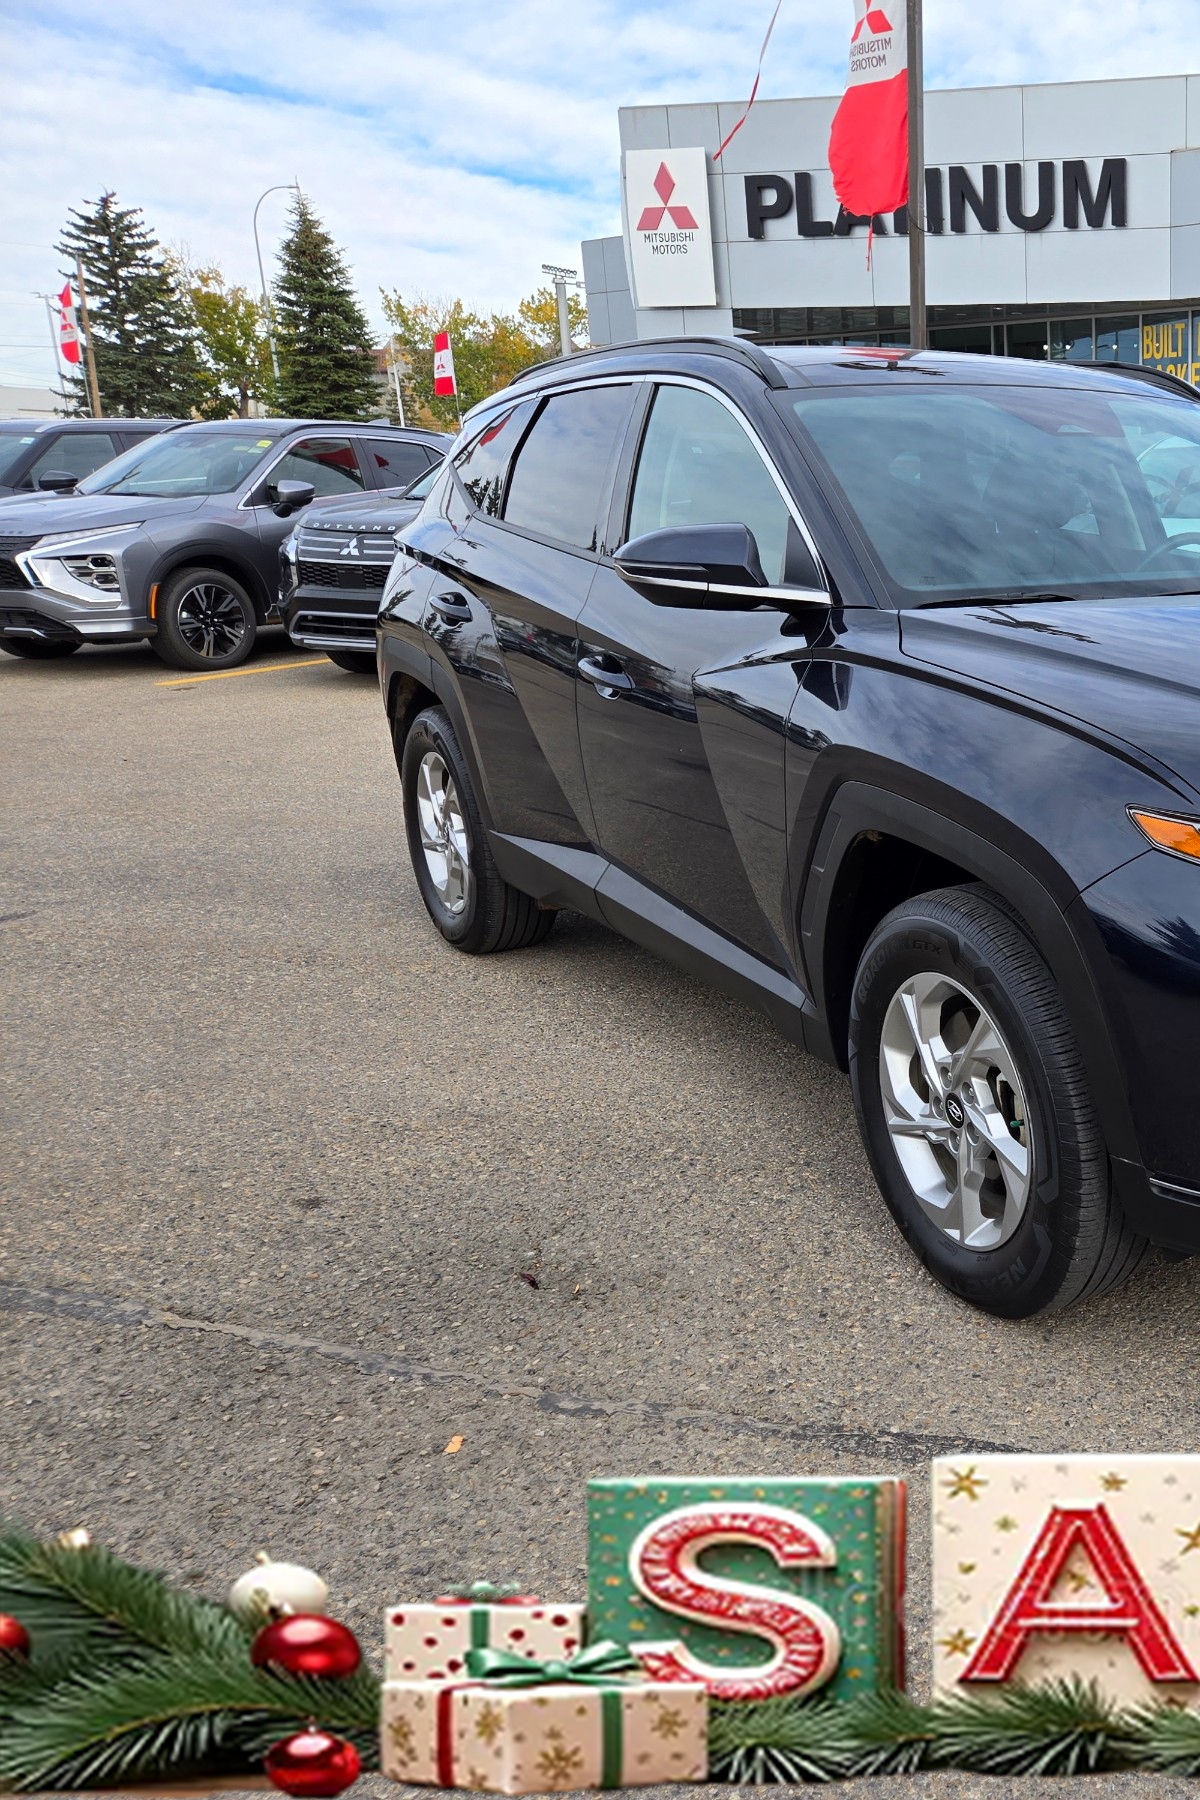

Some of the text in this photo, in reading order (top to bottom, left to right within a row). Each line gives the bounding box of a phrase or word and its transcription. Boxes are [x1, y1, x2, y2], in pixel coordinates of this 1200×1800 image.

[744, 158, 1127, 239] PLINUM
[643, 232, 694, 243] MITSUBISHI
[652, 244, 688, 255] MOTORS
[1143, 323, 1185, 359] BUILT
[313, 522, 396, 531] OUTLAND
